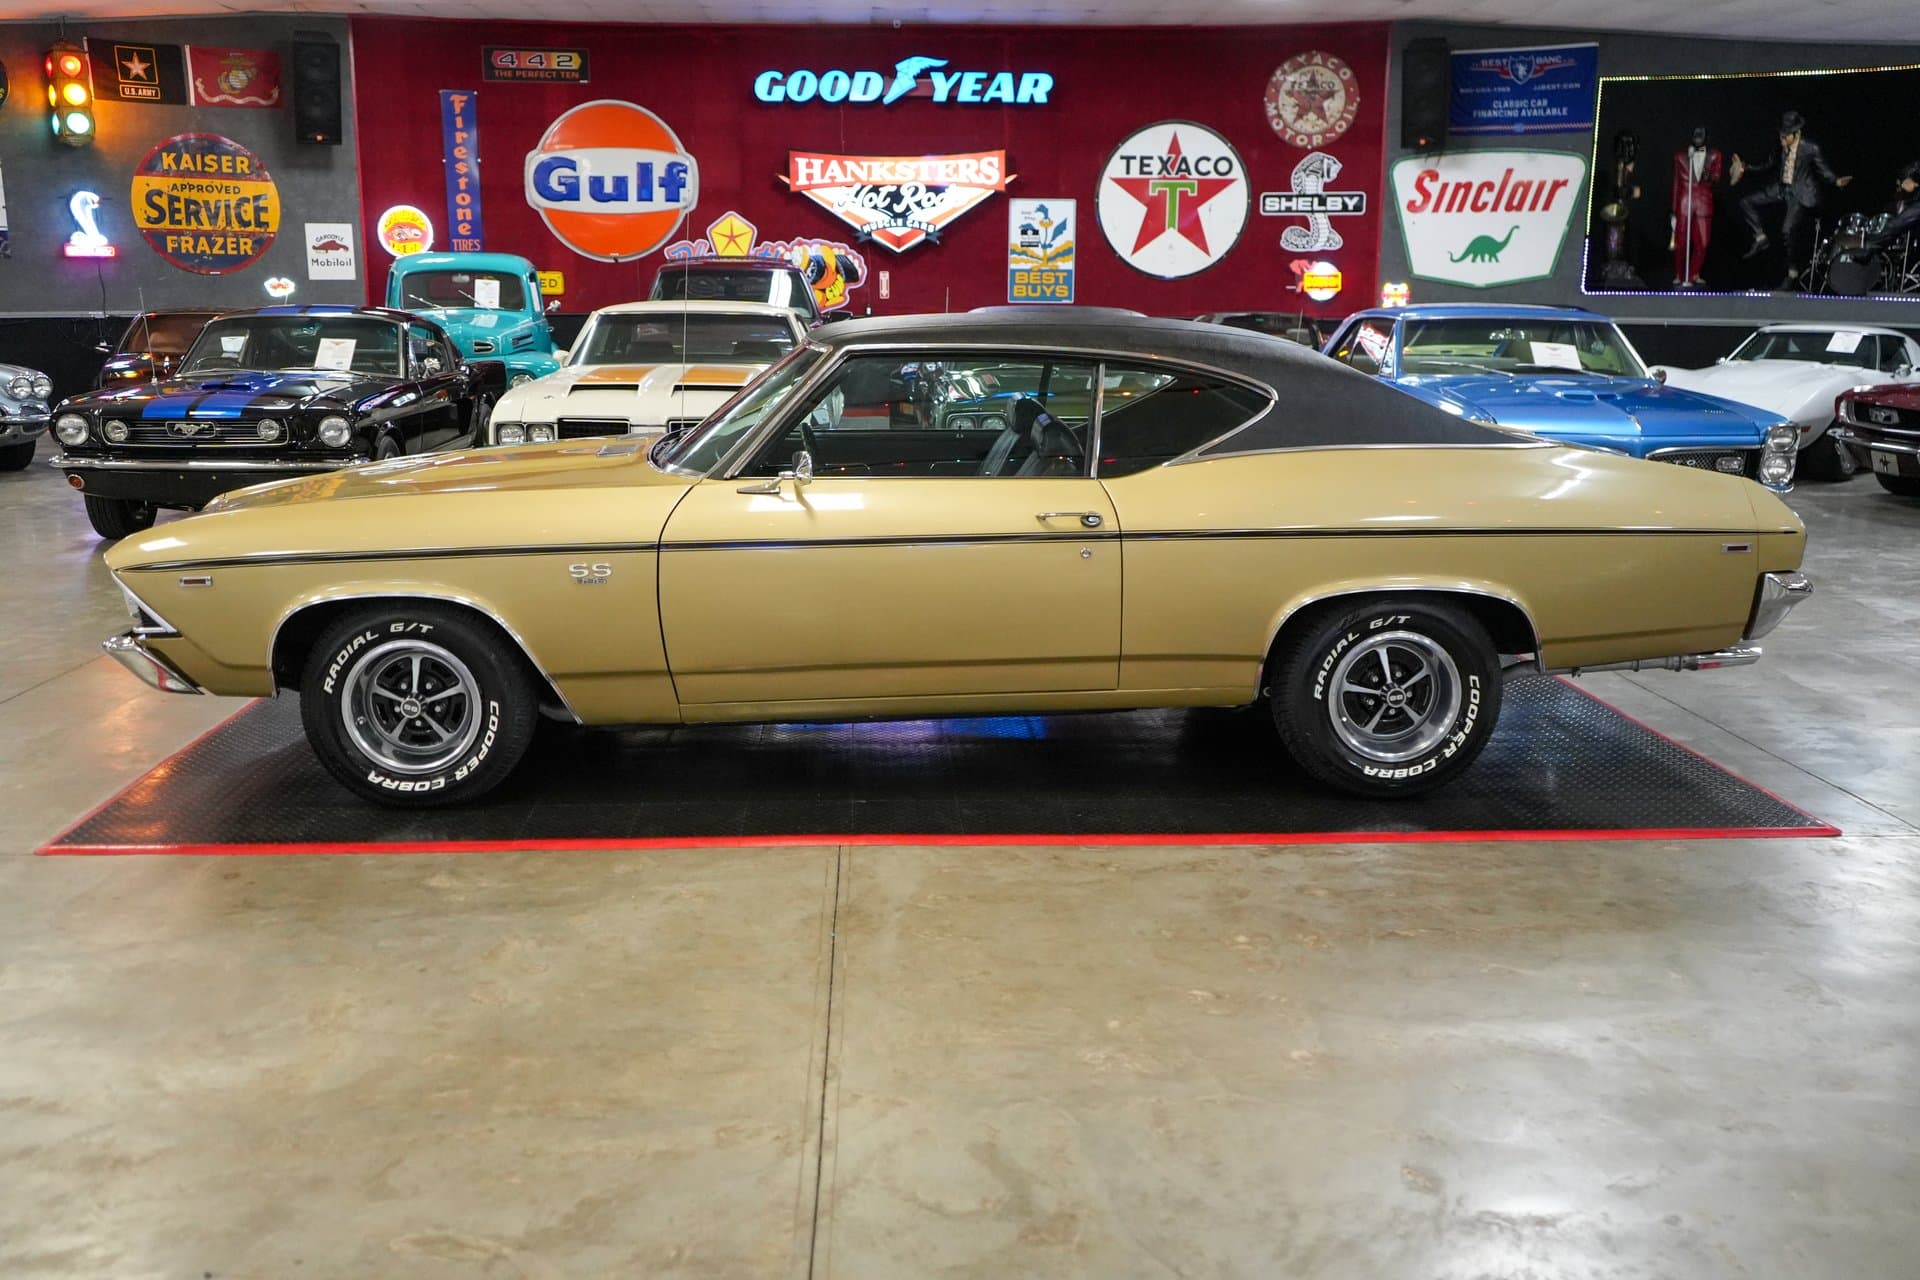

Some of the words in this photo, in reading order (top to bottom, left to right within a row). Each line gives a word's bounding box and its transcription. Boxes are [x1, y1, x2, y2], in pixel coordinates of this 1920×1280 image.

[493, 70, 513, 78] THE
[515, 70, 557, 78] PERFECT
[560, 70, 580, 79] TEN
[754, 70, 884, 103] GOOD
[929, 71, 1054, 103] YEAR
[1473, 108, 1519, 119] FINANCING
[1520, 106, 1568, 118] AVAILABLE
[1492, 99, 1529, 109] CLASSIC
[1531, 98, 1548, 108] CAR
[161, 151, 251, 175] KAISER
[449, 94, 472, 236] Firestone
[794, 156, 1000, 186] HANKSTERS
[1119, 155, 1234, 177] TEXACO
[170, 183, 241, 195] APPROVED
[533, 156, 688, 203] Gulf
[1406, 168, 1569, 213] Sinclair
[144, 188, 270, 230] SERVICE
[1264, 196, 1360, 212] SHELBY
[862, 218, 904, 234] MUSCLE
[906, 218, 936, 234] CARS
[166, 235, 253, 256] FRAZER
[452, 238, 481, 252] TIRES
[311, 257, 352, 267] Mobiloil
[1014, 271, 1068, 285] BEST
[1013, 285, 1069, 298] BUYS
[568, 562, 612, 578] SS
[323, 631, 379, 695] RADIAL
[390, 622, 434, 633] G/T
[1313, 632, 1360, 700] RADIAL
[1369, 615, 1411, 630] G/T
[1443, 675, 1480, 759] COOPER
[455, 700, 499, 781] COOPER
[1363, 759, 1437, 780] COBRA
[367, 770, 446, 792] COBRA
